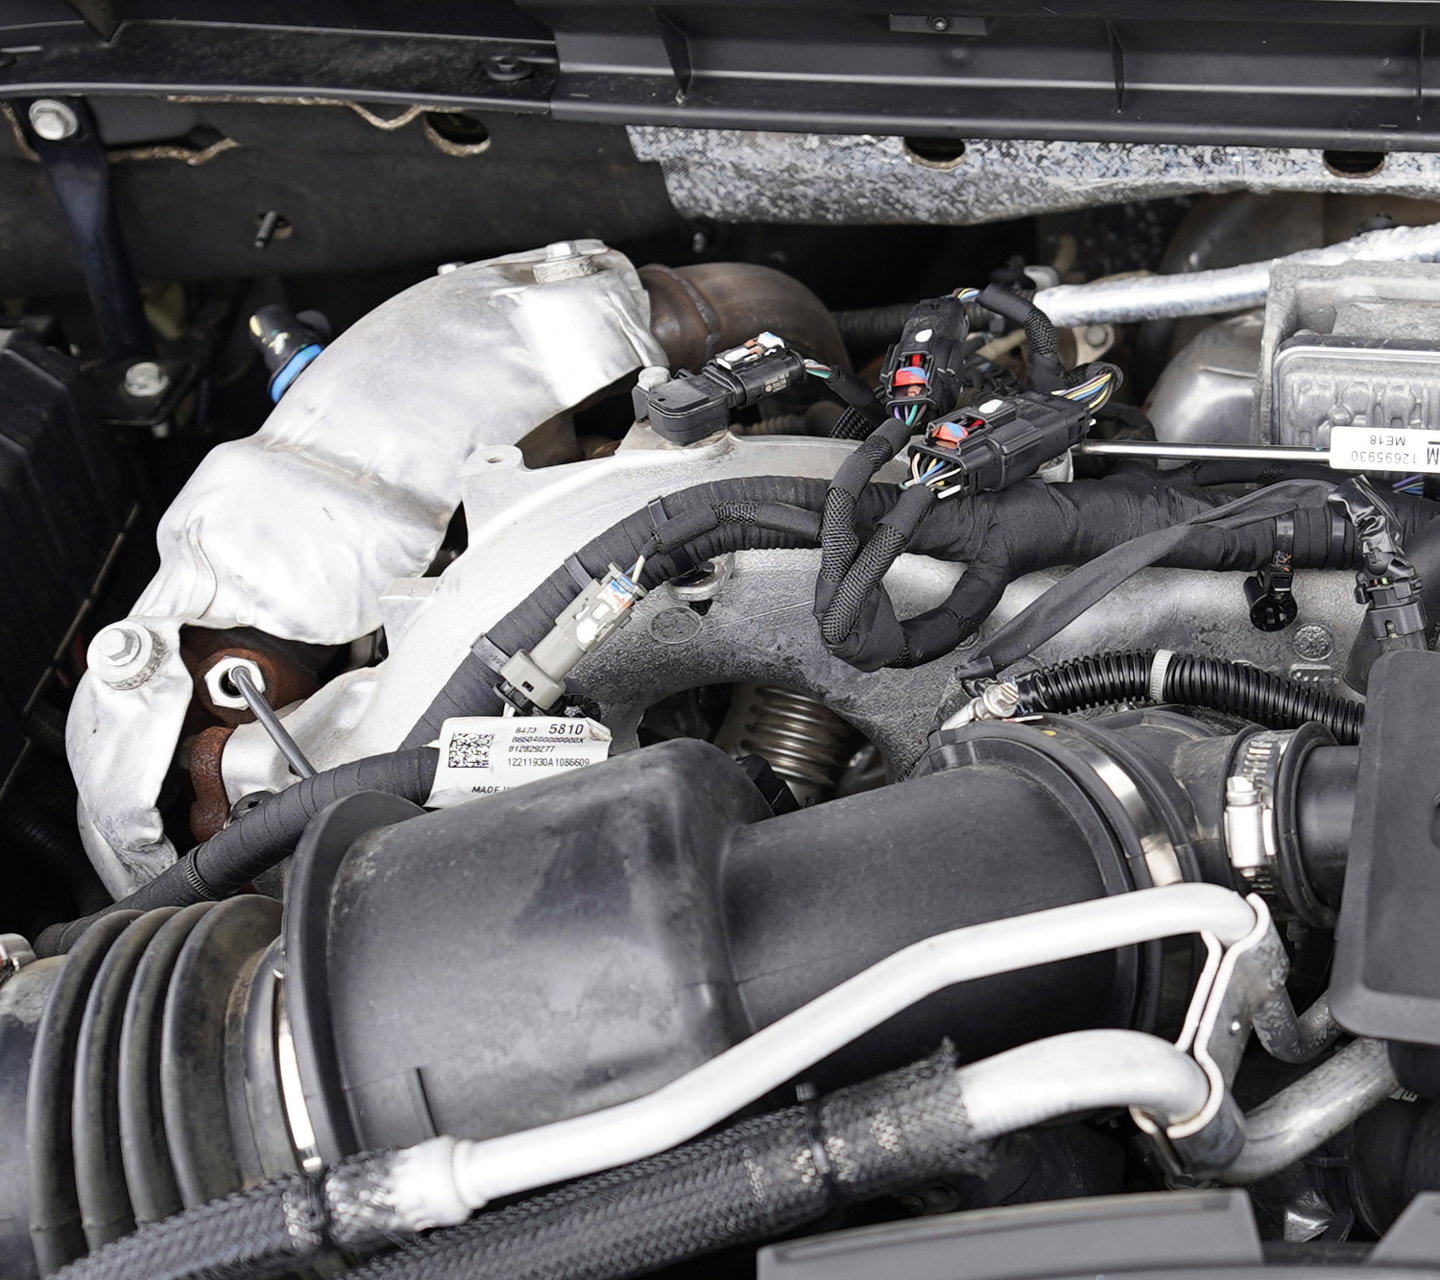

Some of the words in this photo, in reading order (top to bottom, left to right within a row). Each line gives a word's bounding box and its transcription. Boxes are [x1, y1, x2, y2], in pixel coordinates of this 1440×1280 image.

[1369, 434, 1406, 446] ME18
[1350, 450, 1417, 464] 12695930
[548, 723, 583, 735] 5810
